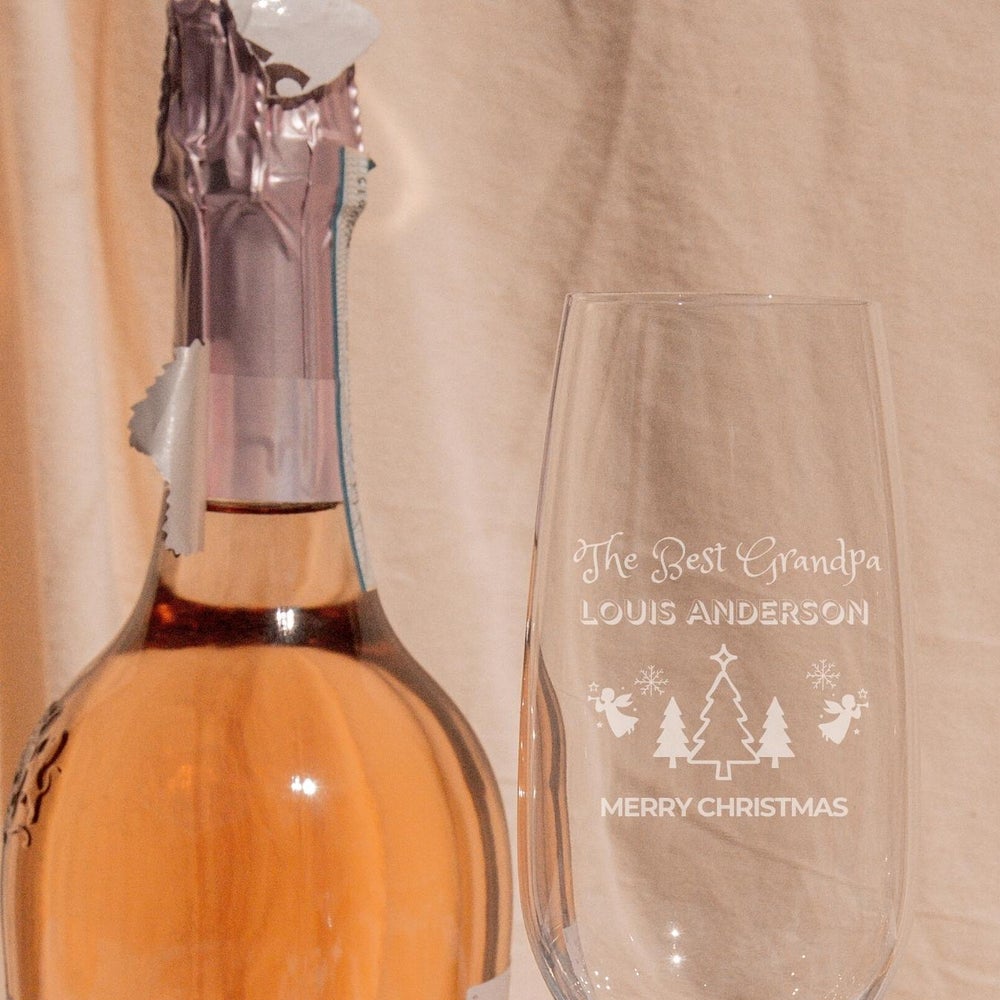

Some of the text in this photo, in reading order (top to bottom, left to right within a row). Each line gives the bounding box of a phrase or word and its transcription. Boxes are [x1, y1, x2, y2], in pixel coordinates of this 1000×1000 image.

[573, 532, 883, 587] The Best Grandpa
[580, 599, 869, 626] LOUIS ANDERSON
[600, 796, 849, 818] MERRY CHRISTMAS
